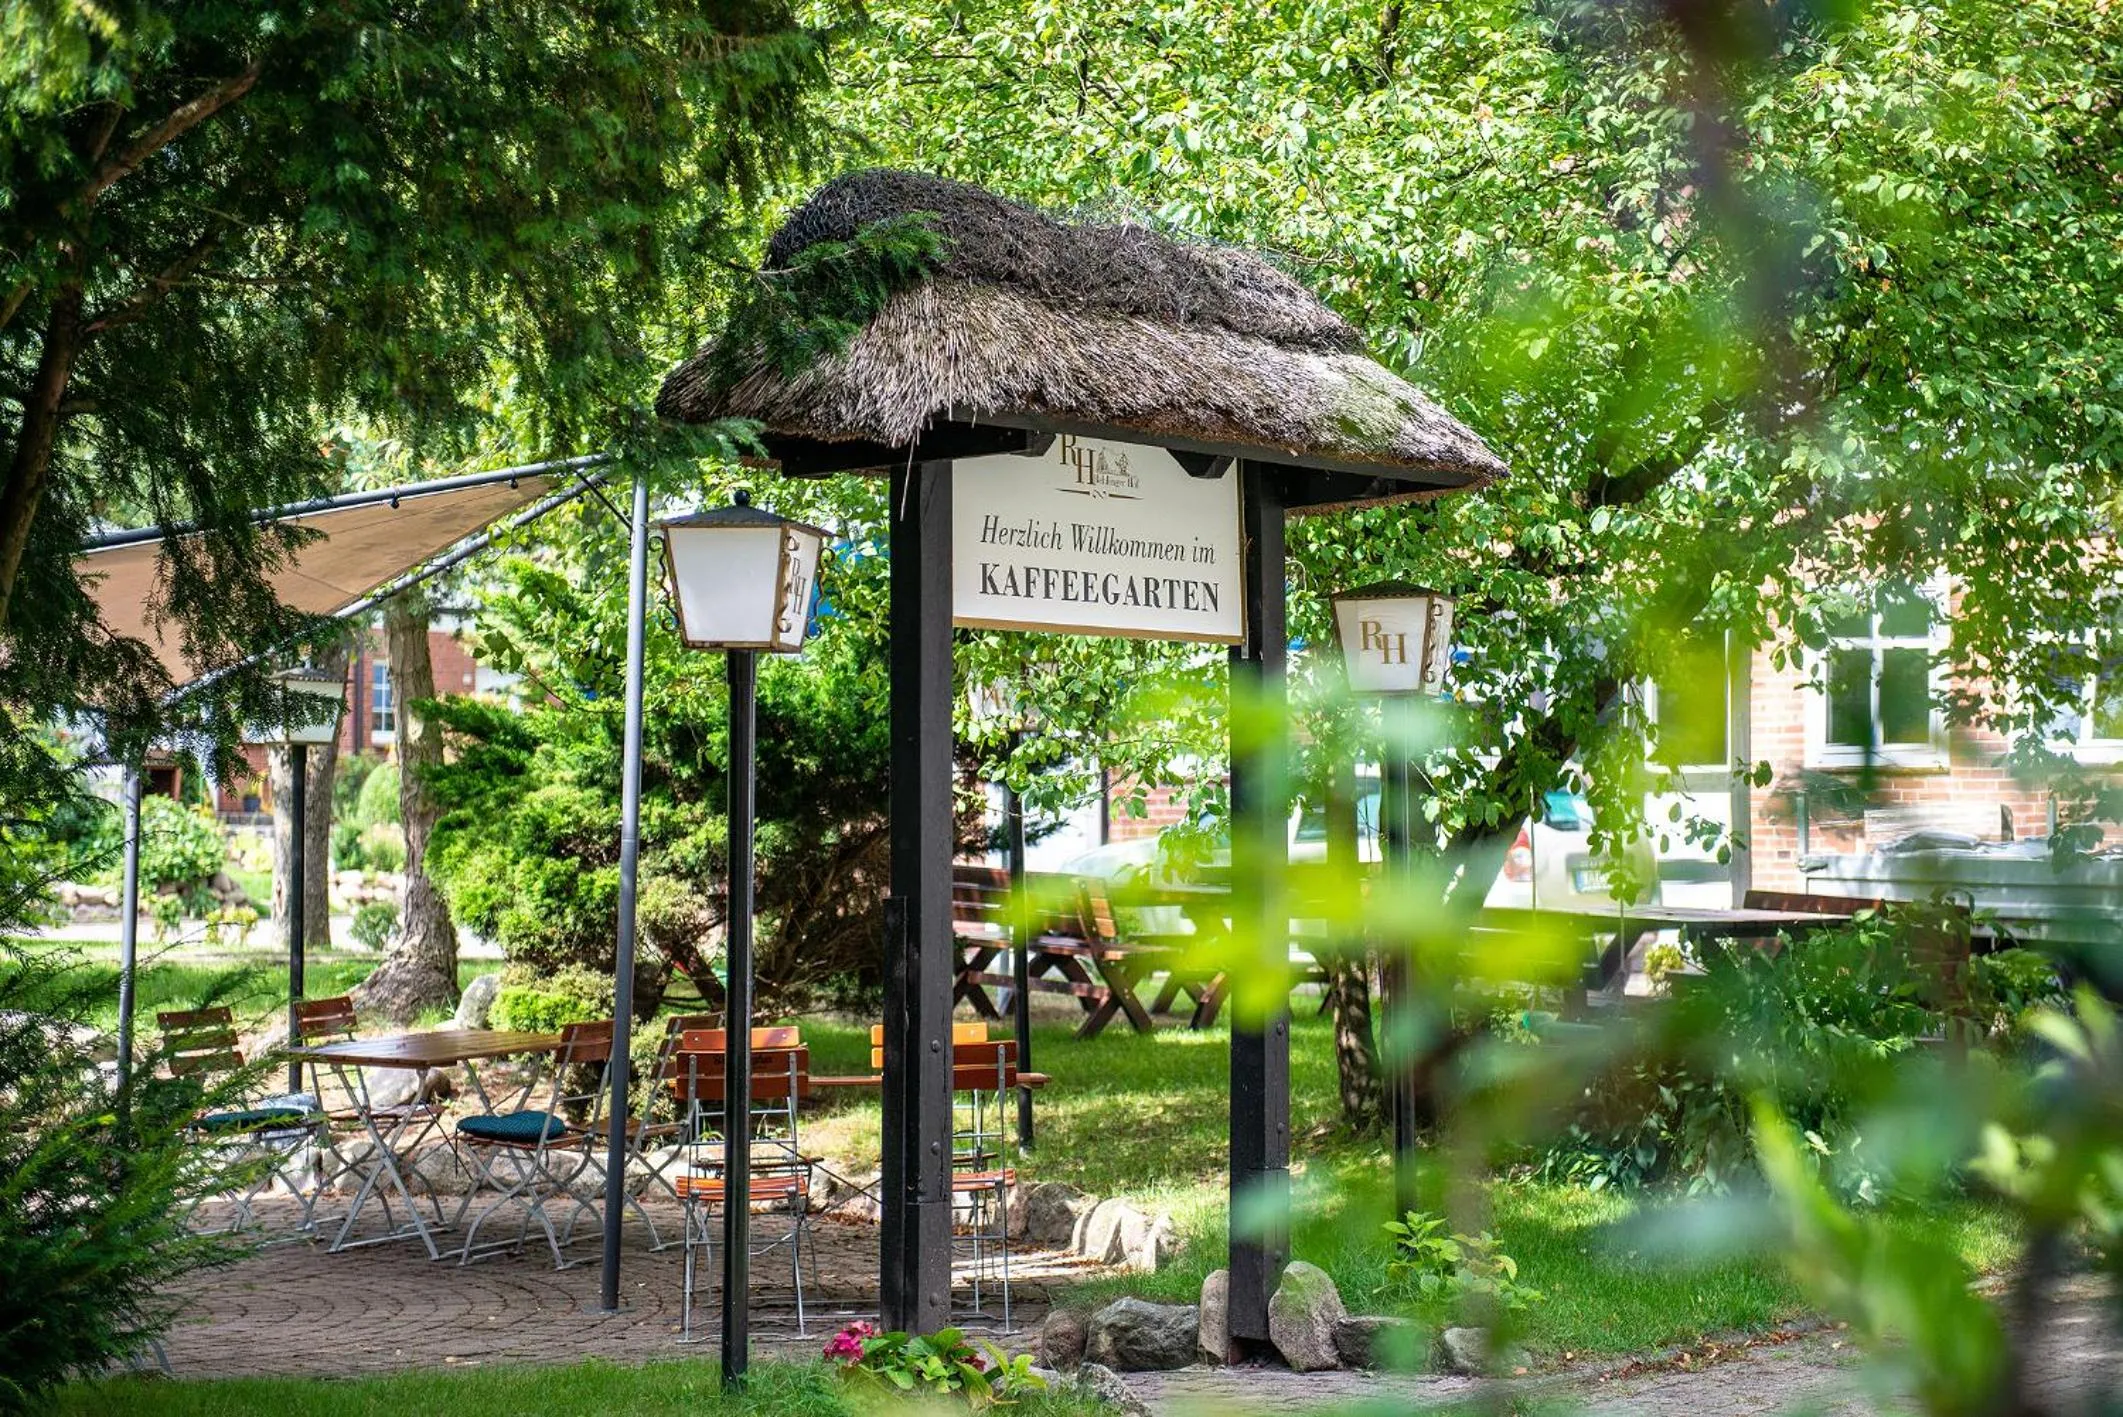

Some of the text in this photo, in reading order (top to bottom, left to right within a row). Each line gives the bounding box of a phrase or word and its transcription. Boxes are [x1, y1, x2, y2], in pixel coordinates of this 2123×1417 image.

[980, 514, 1216, 564] Herzlich Willkommen im
[979, 562, 1219, 613] KAFFEEGARTEN
[1359, 620, 1407, 665] RH
